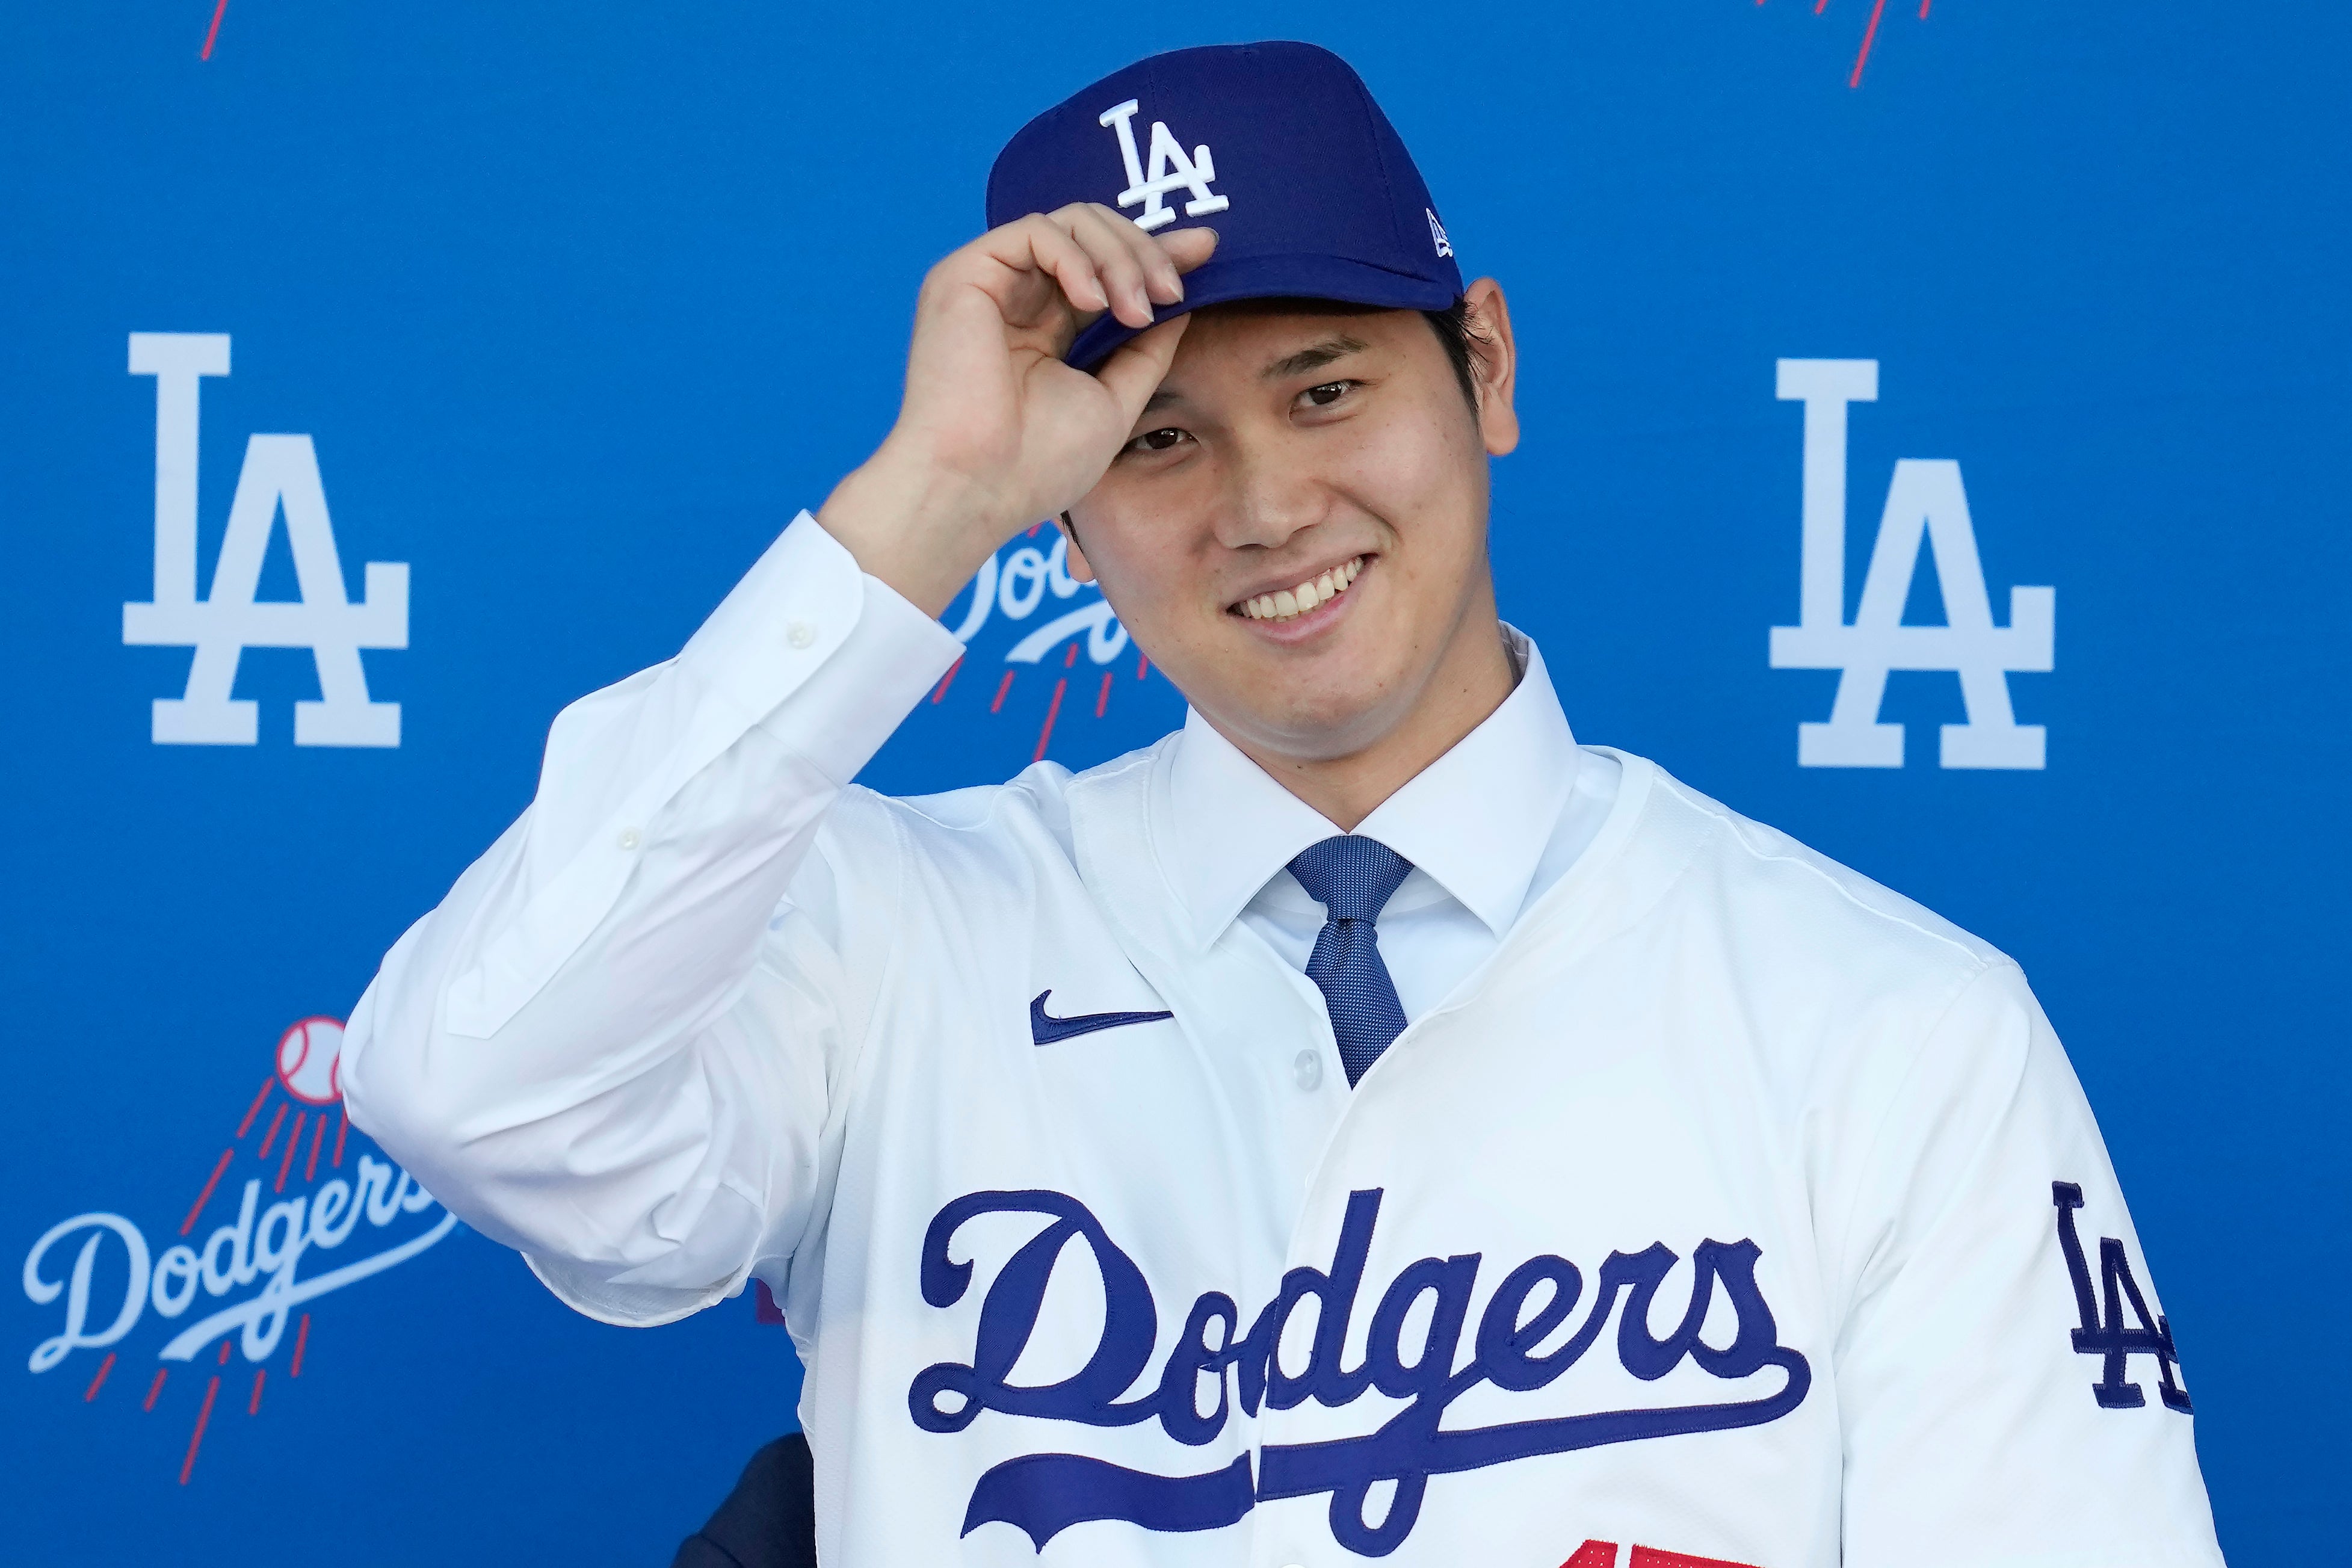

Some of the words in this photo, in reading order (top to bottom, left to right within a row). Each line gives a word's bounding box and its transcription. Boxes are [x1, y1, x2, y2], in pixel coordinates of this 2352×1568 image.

[1099, 99, 1229, 231] LA
[123, 332, 409, 747] LA
[1770, 359, 2055, 770] LA
[909, 1187, 1811, 1557] Dodgers
[2052, 1180, 2193, 1415] LA
